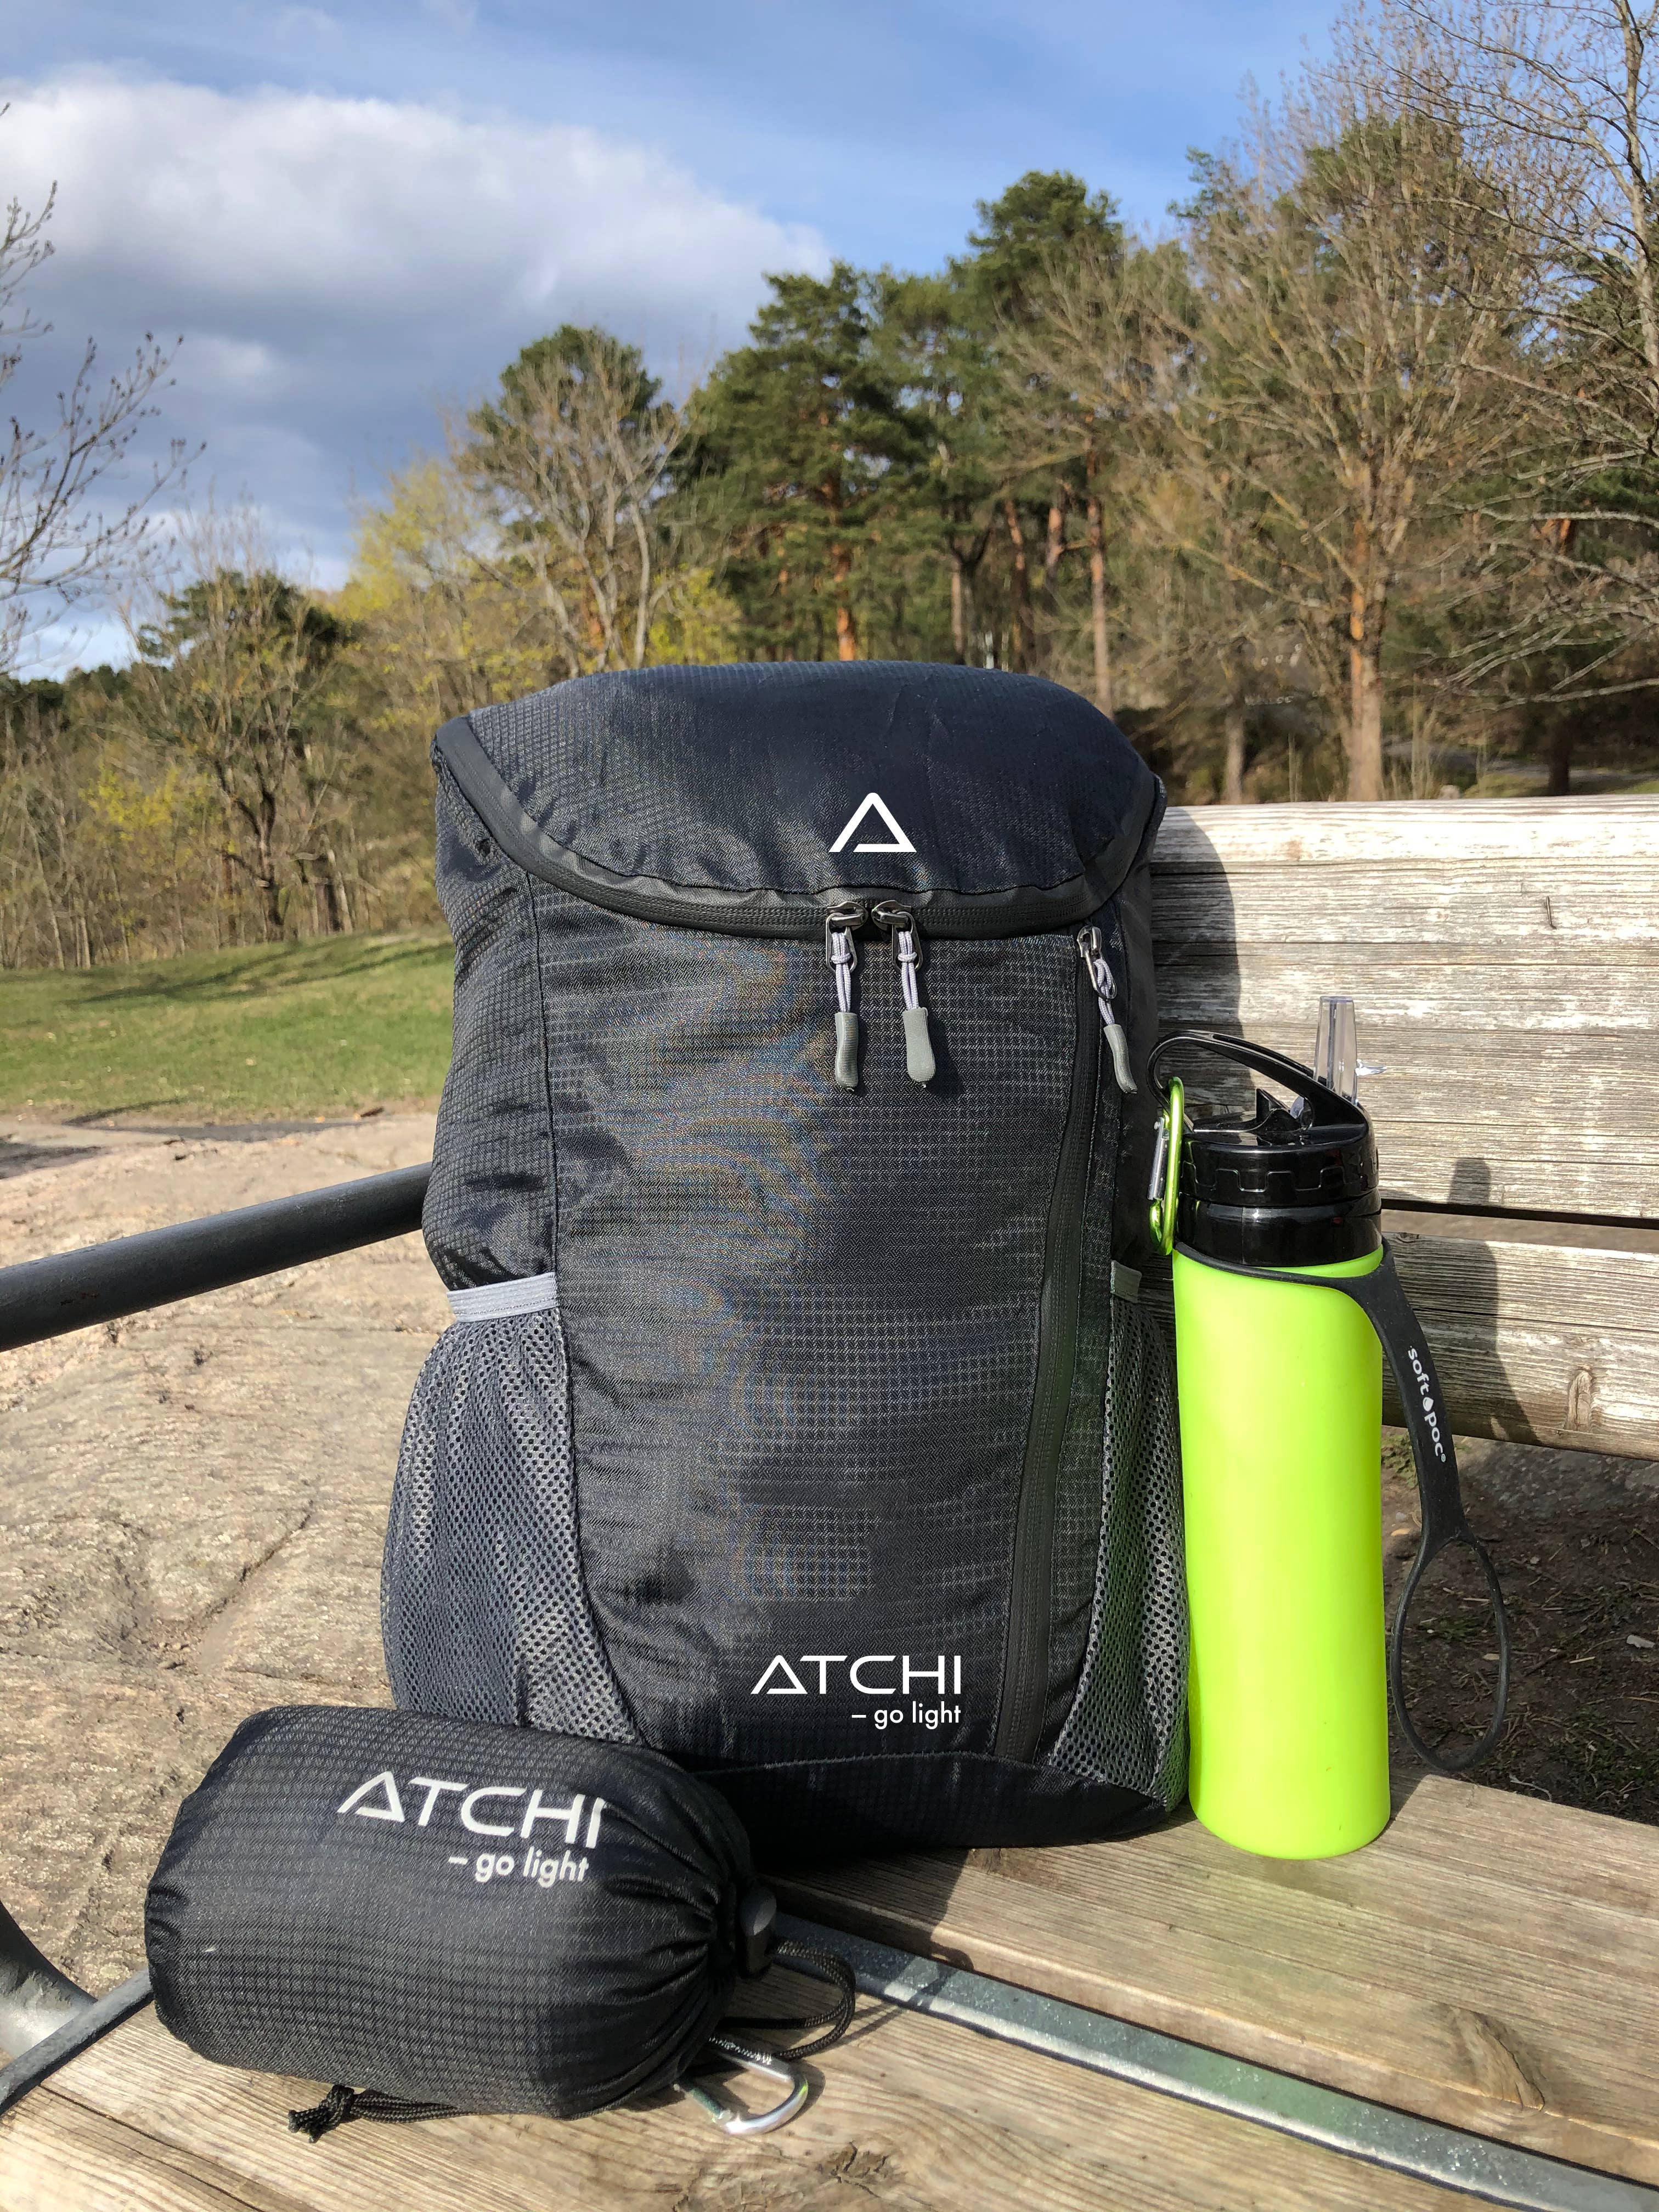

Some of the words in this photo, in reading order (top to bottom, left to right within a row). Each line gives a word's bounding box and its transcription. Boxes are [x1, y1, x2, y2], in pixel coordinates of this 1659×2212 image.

[1407, 1347, 1430, 1396] soft
[751, 1655, 961, 1695] ATCHI
[874, 1709, 904, 1730] go
[912, 1701, 961, 1730] light
[336, 1771, 606, 1849] ATCHI
[475, 1852, 515, 1886] go
[522, 1846, 589, 1888] light
